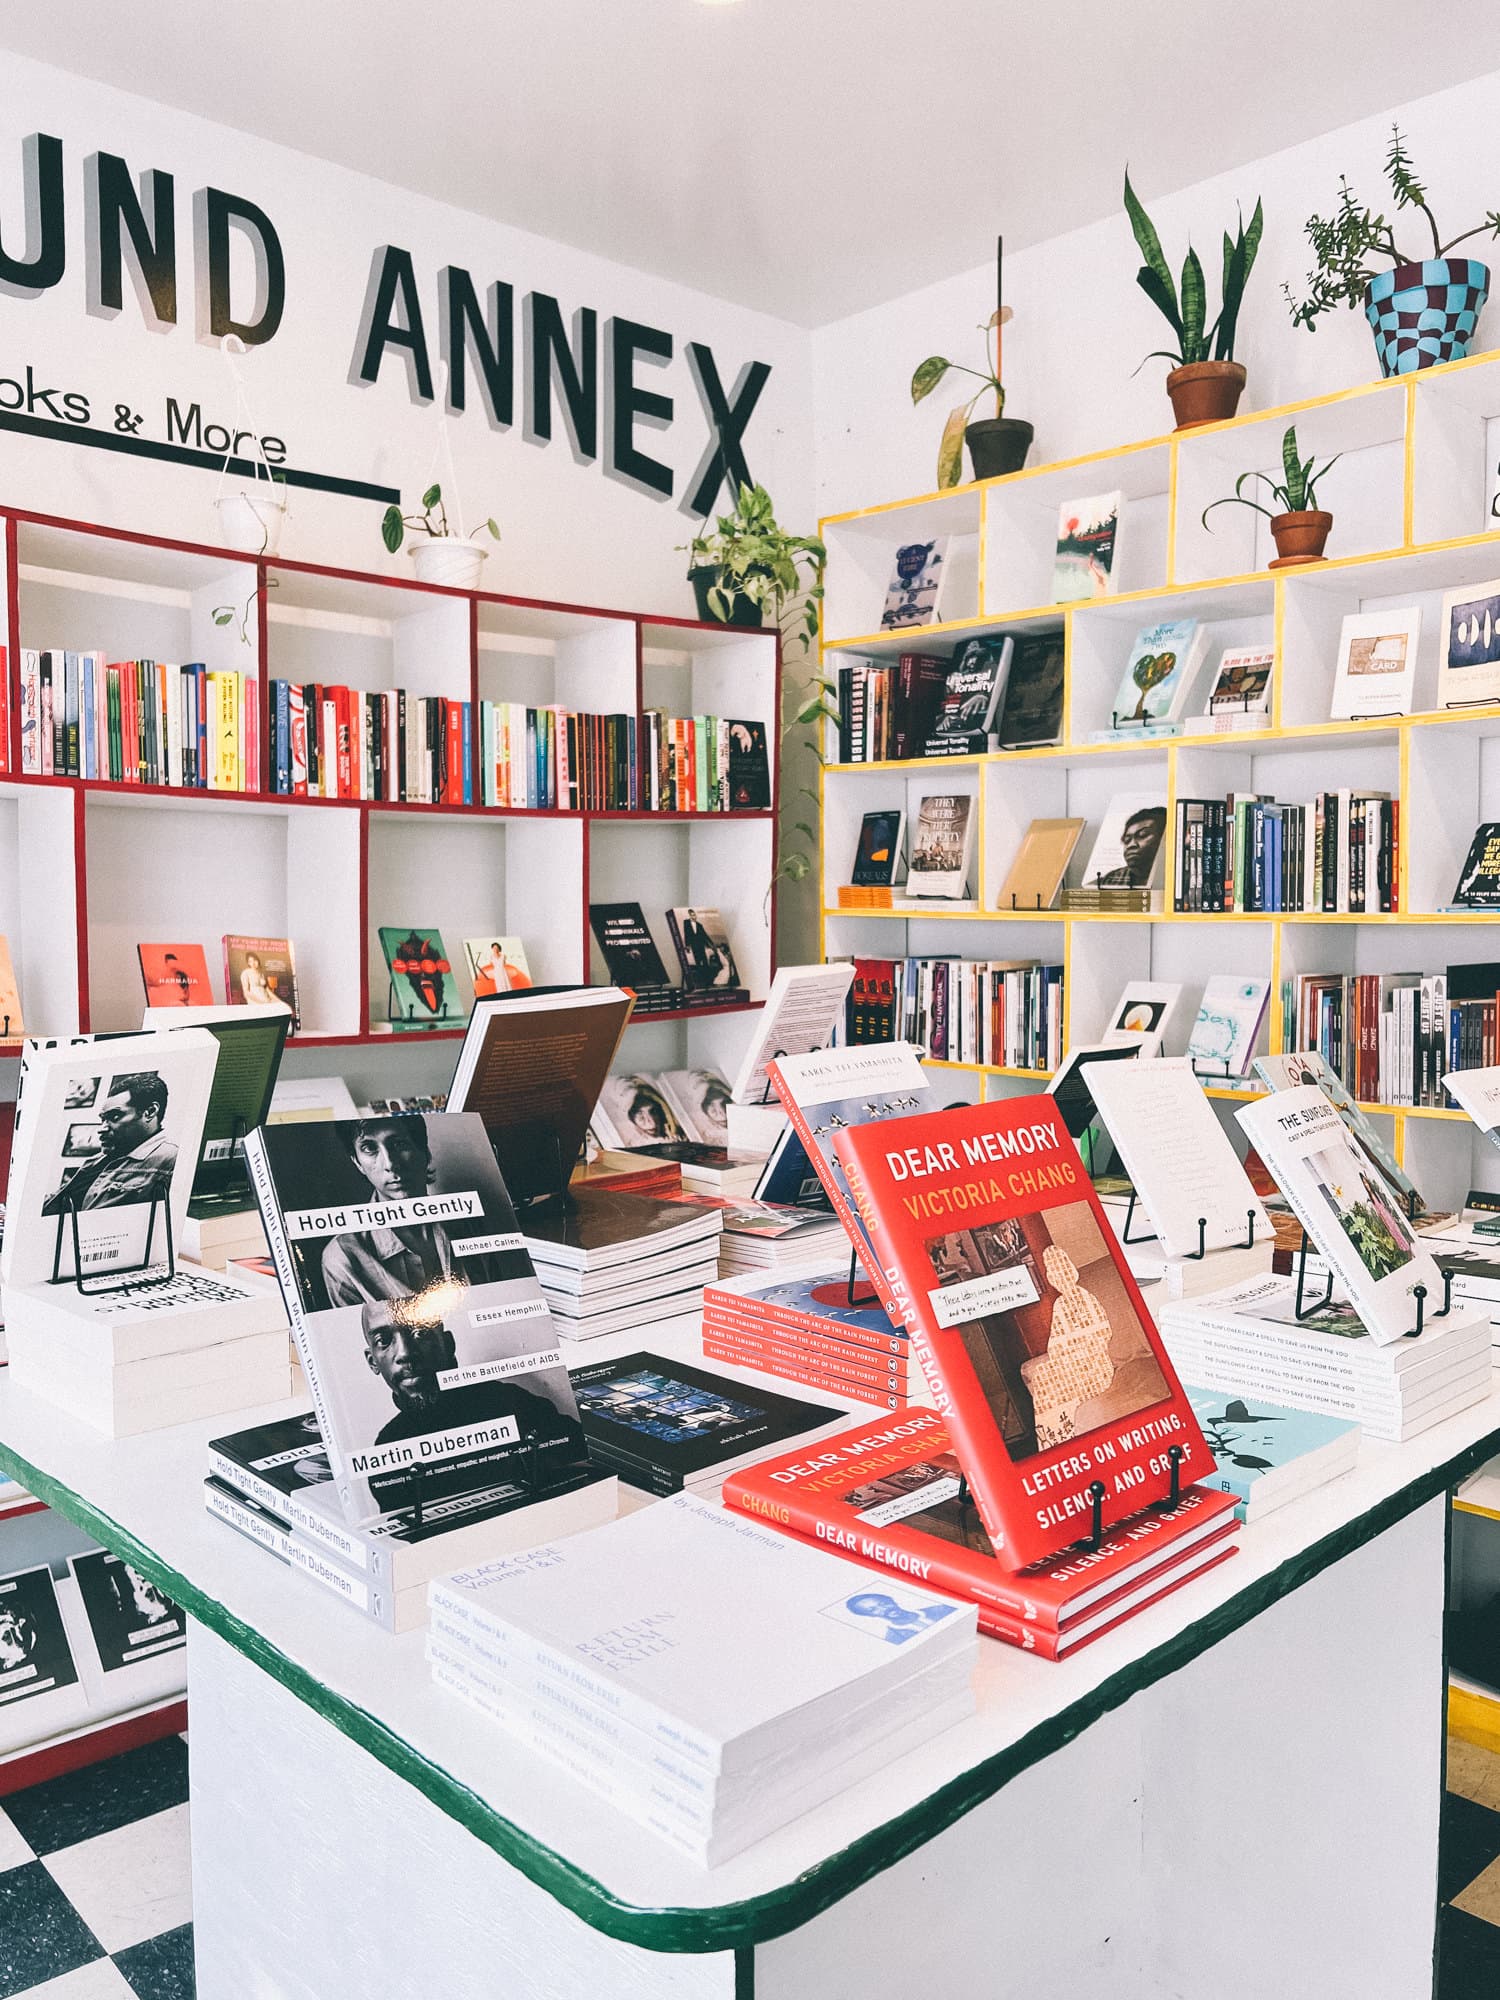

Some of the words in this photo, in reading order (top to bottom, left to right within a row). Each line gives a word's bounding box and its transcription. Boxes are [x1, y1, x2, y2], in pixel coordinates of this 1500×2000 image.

[348, 244, 772, 520] ANNEX
[113, 402, 145, 435] &
[165, 397, 288, 465] More
[953, 680, 995, 694] Tonality
[932, 809, 956, 819] WERE
[934, 798, 955, 808] THEY
[1434, 995, 1443, 1017] JUST
[1434, 1017, 1443, 1033] US
[1277, 1112, 1302, 1131] THE
[1302, 1104, 1334, 1122] SUNFLOWER
[886, 1142, 961, 1182] DEAR
[960, 1122, 1061, 1173] MEMORY
[299, 1212, 346, 1232] Hold
[357, 1203, 407, 1226] Tight
[412, 1196, 475, 1218] Gently
[903, 1178, 1006, 1221] VICTORIA
[1007, 1162, 1077, 1198] CHANG
[814, 1155, 834, 1190] THROUGH
[831, 1188, 842, 1203] THE
[838, 1203, 848, 1218] ARC
[845, 1218, 853, 1229] OF
[851, 1228, 861, 1243] THE
[858, 1242, 871, 1261] RAIN
[867, 1261, 884, 1290] FOREST
[252, 1151, 267, 1190] Hold
[260, 1190, 278, 1234] Tight
[271, 1236, 292, 1288] Gently
[291, 1301, 311, 1354] Martin
[304, 1356, 335, 1447] Duberman
[844, 1162, 880, 1233] CHANG
[885, 1266, 914, 1325] DEAR
[910, 1325, 956, 1420] MEMORY
[442, 1374, 460, 1385] and
[462, 1370, 478, 1382] the
[479, 1360, 525, 1378] Battlefield
[527, 1357, 538, 1368] of
[538, 1353, 561, 1365] AIDS
[263, 1449, 311, 1466] Hold
[352, 1446, 414, 1474] Martin
[419, 1425, 511, 1457] Duberman
[770, 1453, 848, 1484] DEAR
[840, 1414, 942, 1457] MEMORY
[799, 1451, 902, 1494] VICTORIA
[899, 1429, 952, 1455] CHAN
[1021, 1450, 1092, 1497] LETTERS
[1094, 1445, 1117, 1468] ON
[1118, 1412, 1188, 1459] WRITING,
[216, 1458, 233, 1477] Hold
[234, 1466, 252, 1488] Tight
[253, 1480, 277, 1507] Gently
[282, 1498, 307, 1525] Martin
[309, 1515, 352, 1553] Duberman
[1036, 1486, 1111, 1530] SILENC,
[1114, 1465, 1147, 1494] AND
[213, 1495, 229, 1515] Hold
[230, 1505, 250, 1528] Tight
[250, 1519, 276, 1546] Gently
[281, 1537, 307, 1565] Martin
[308, 1556, 352, 1595] Duberman
[673, 1497, 689, 1510] by
[688, 1503, 736, 1530] Joseph
[735, 1526, 785, 1552] Jarman
[741, 1494, 790, 1524] CHANG
[815, 1521, 857, 1552] DEAR
[861, 1537, 933, 1580] MEMORY
[1050, 1539, 1131, 1582] SILENCE,
[1126, 1520, 1162, 1541] AND
[1159, 1495, 1204, 1523] GRIEF
[450, 1561, 511, 1585] BLACK
[510, 1546, 564, 1565] CASE
[462, 1566, 525, 1592] Volume
[535, 1558, 553, 1571] &
[1026, 1534, 1094, 1571] LETTES
[576, 1611, 676, 1654] RETURN
[591, 1629, 663, 1664] FROM
[607, 1638, 681, 1674] EXILE
